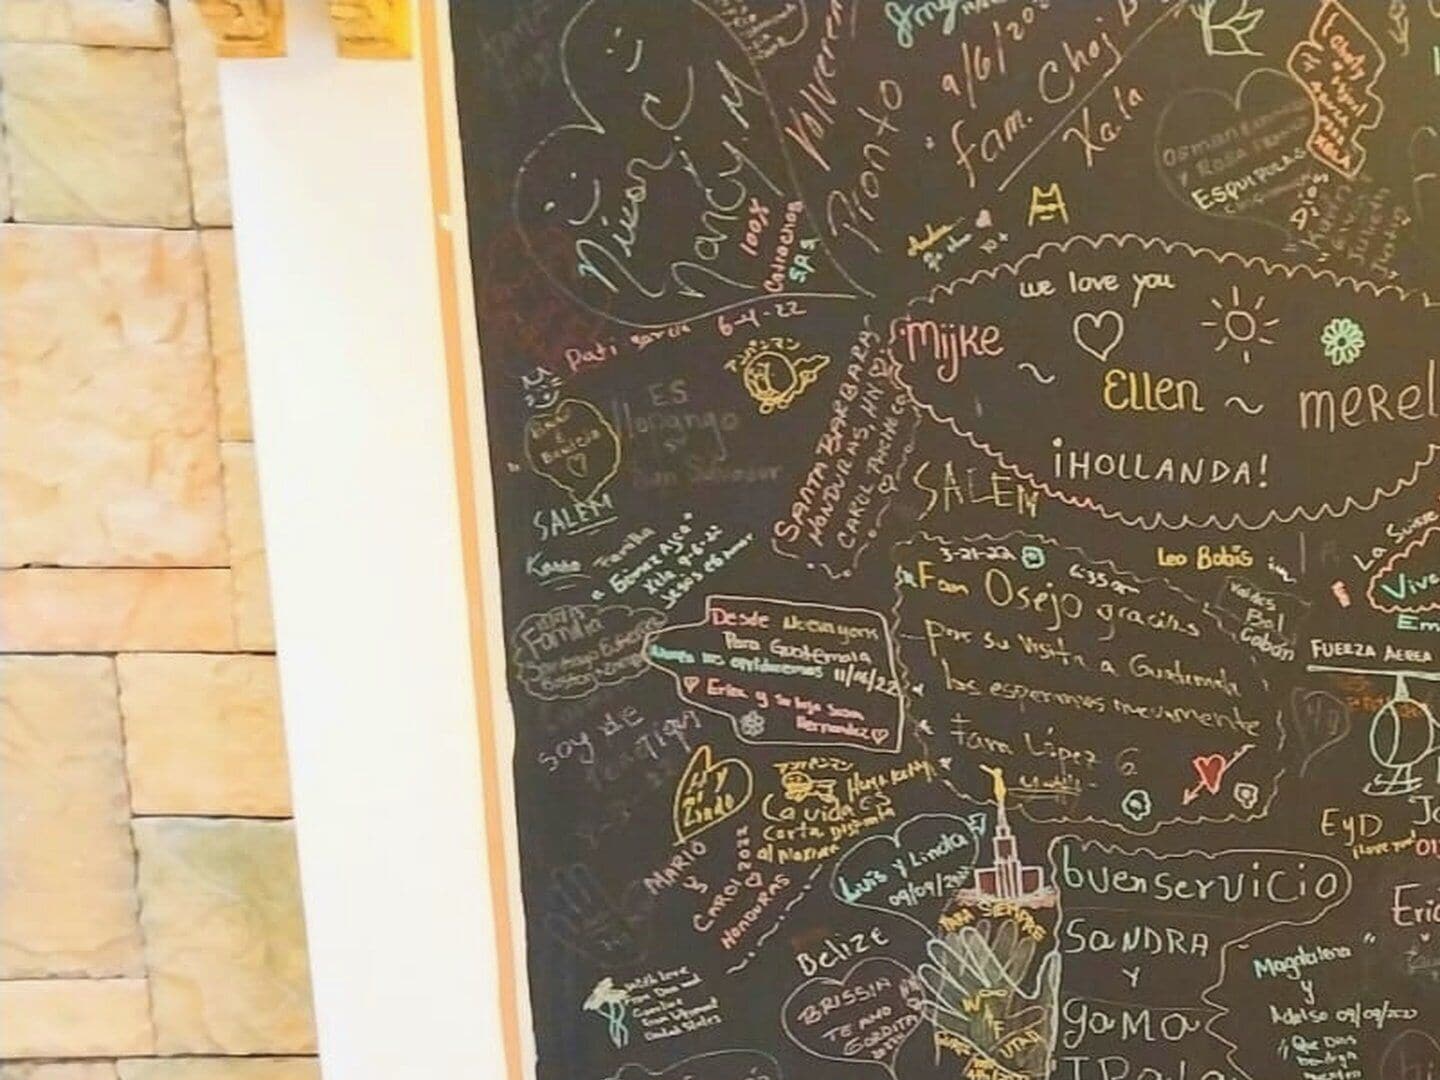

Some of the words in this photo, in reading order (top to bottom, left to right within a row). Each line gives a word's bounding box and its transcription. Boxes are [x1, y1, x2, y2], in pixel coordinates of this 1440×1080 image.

[1069, 271, 1120, 294] love
[1132, 273, 1177, 308] you
[1103, 368, 1205, 414] Ellen
